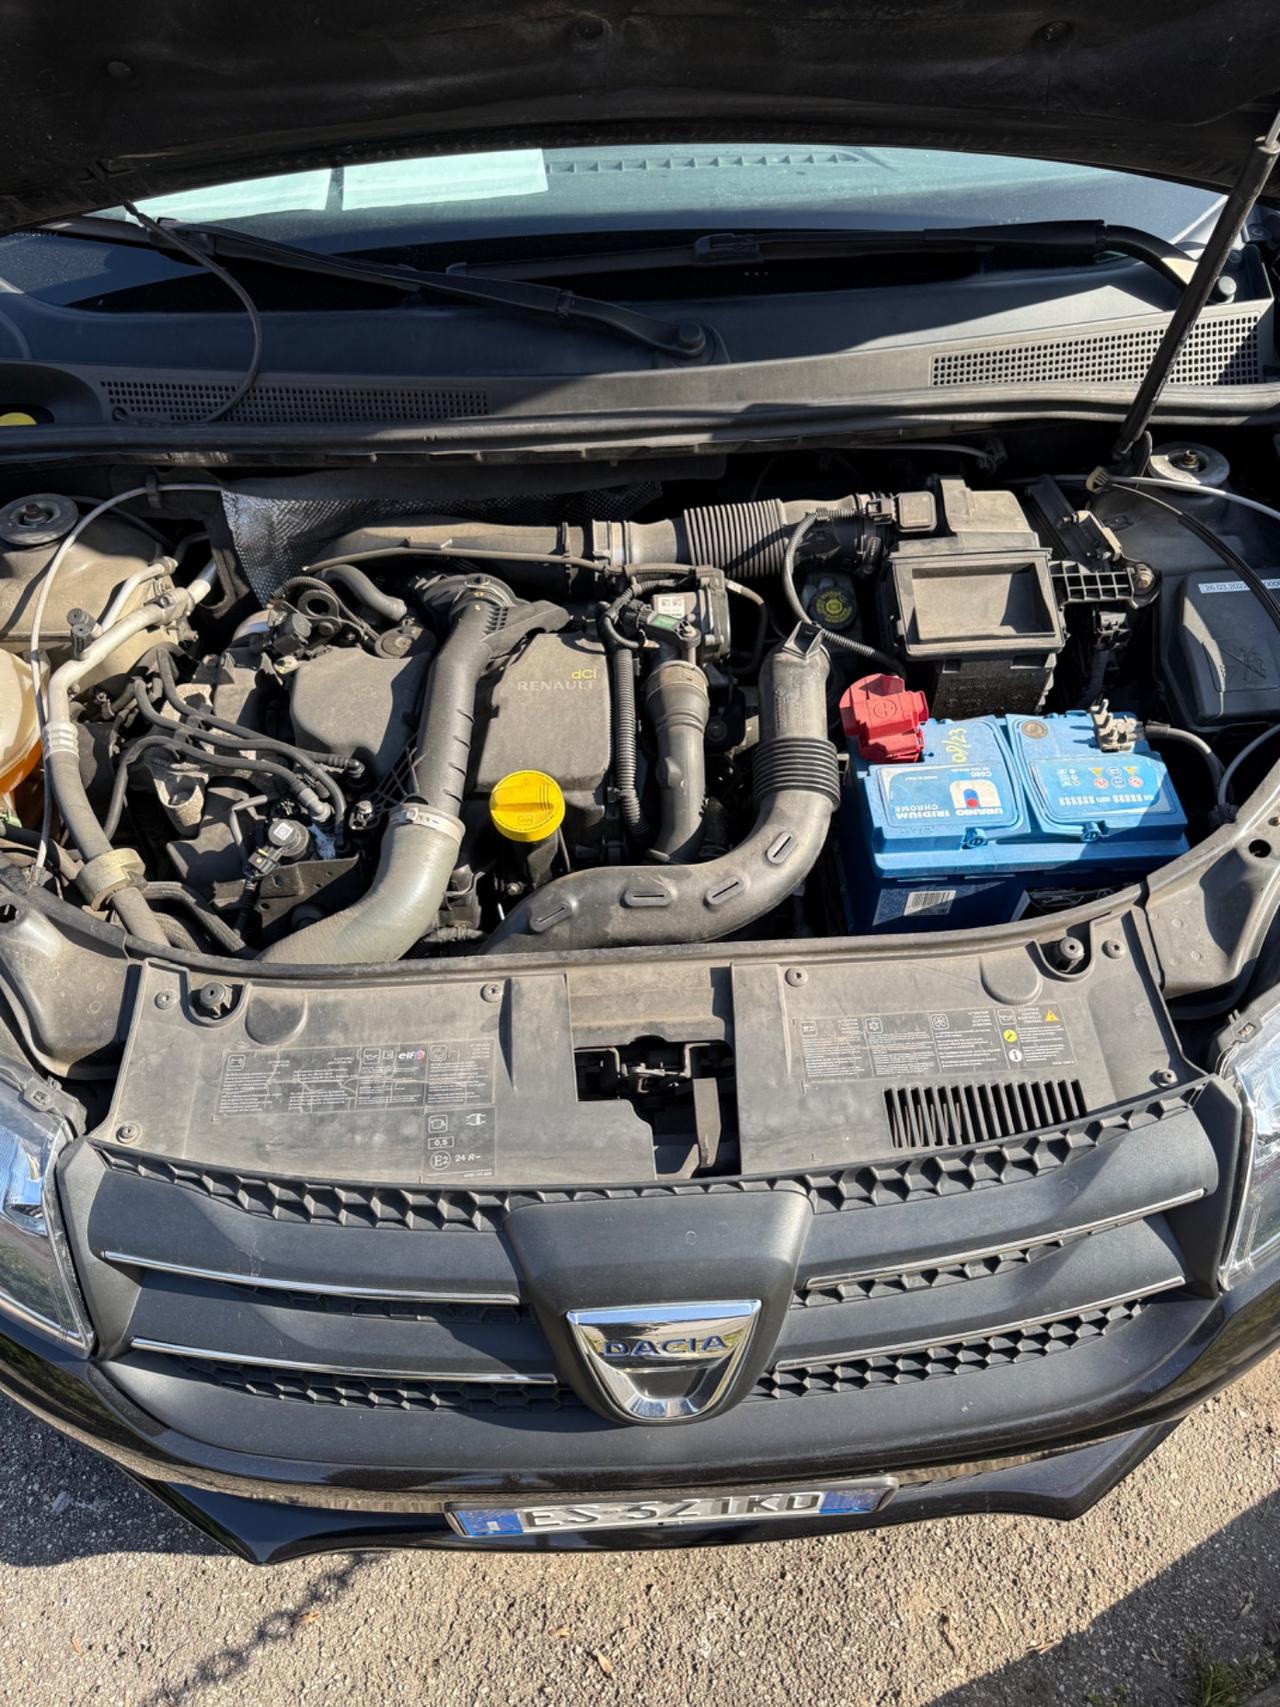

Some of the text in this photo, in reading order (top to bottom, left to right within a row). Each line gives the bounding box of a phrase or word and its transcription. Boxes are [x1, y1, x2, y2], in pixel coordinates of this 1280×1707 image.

[572, 669, 597, 679] dCi
[518, 680, 593, 691] RENAULT
[894, 803, 939, 812] CHROME
[895, 809, 951, 820] IRIDIUM
[398, 1051, 416, 1060] elf
[602, 1335, 728, 1358] DACIA
[525, 1506, 600, 1528] ES
